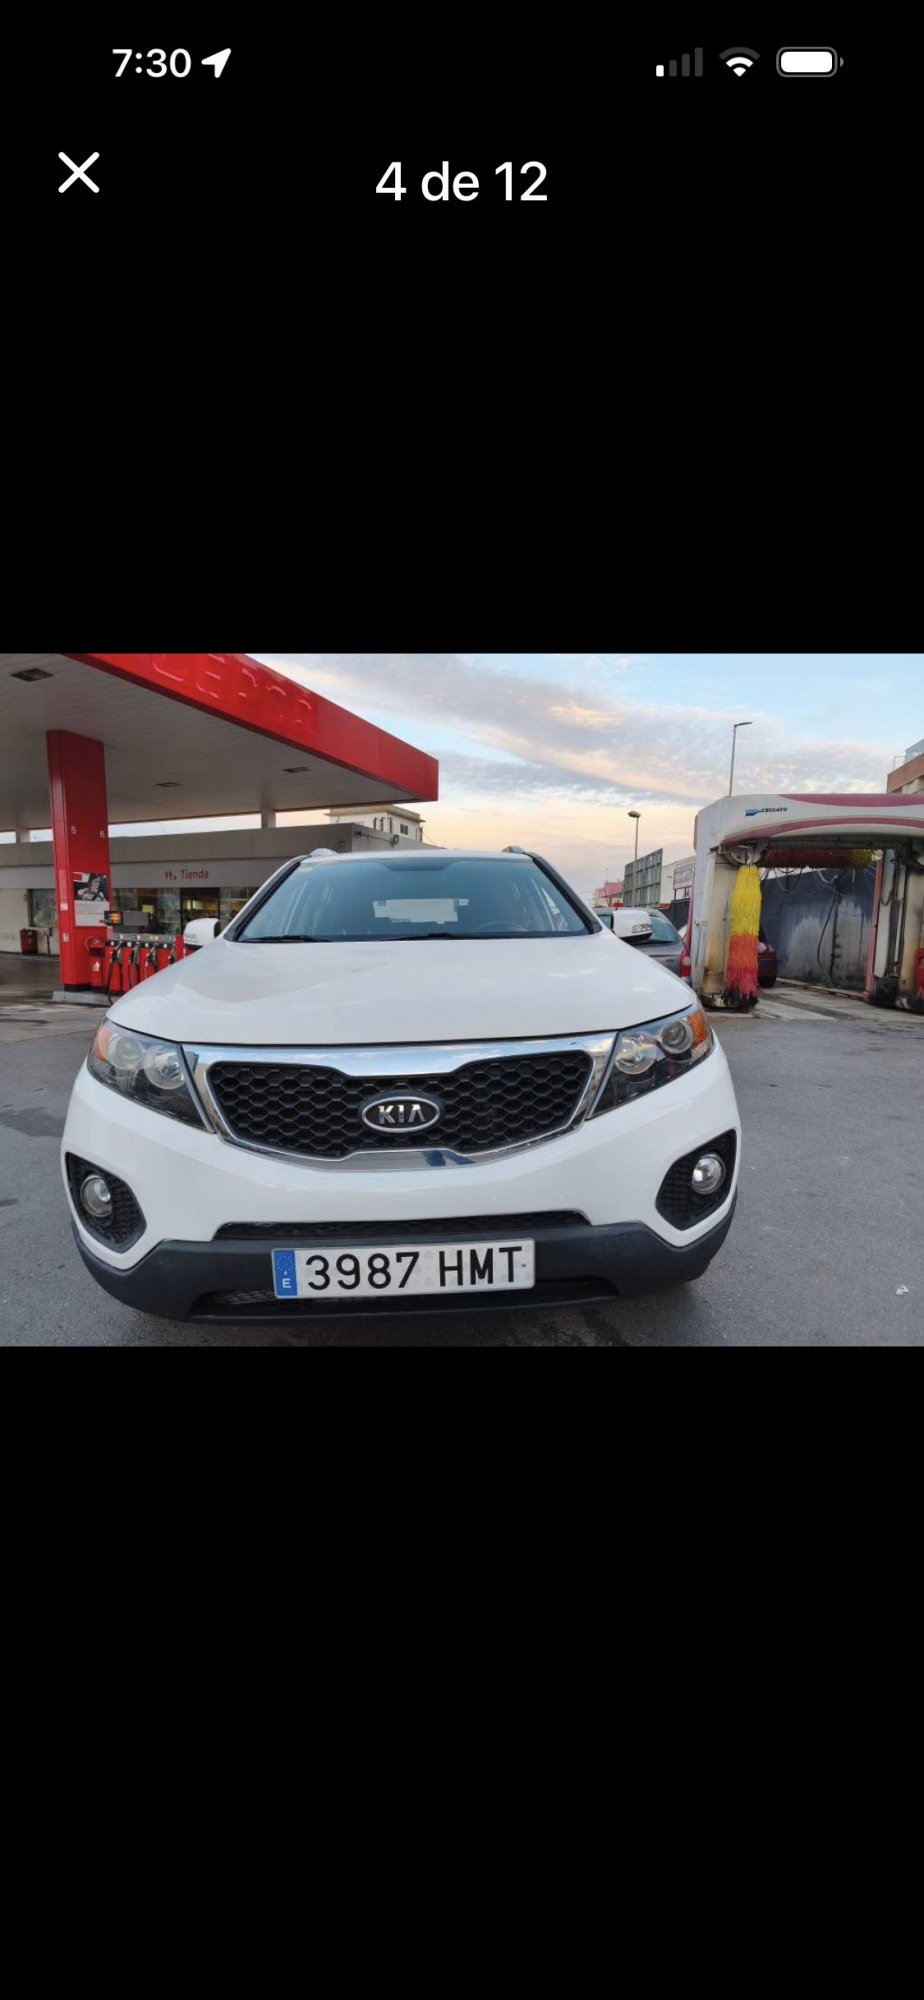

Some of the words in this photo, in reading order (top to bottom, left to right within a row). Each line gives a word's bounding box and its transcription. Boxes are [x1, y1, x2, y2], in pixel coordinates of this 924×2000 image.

[180, 868, 209, 879] Tienda
[377, 1104, 426, 1124] KIA
[305, 1251, 420, 1290] 3987
[438, 1246, 523, 1287] HMT
[282, 1278, 291, 1289] E
